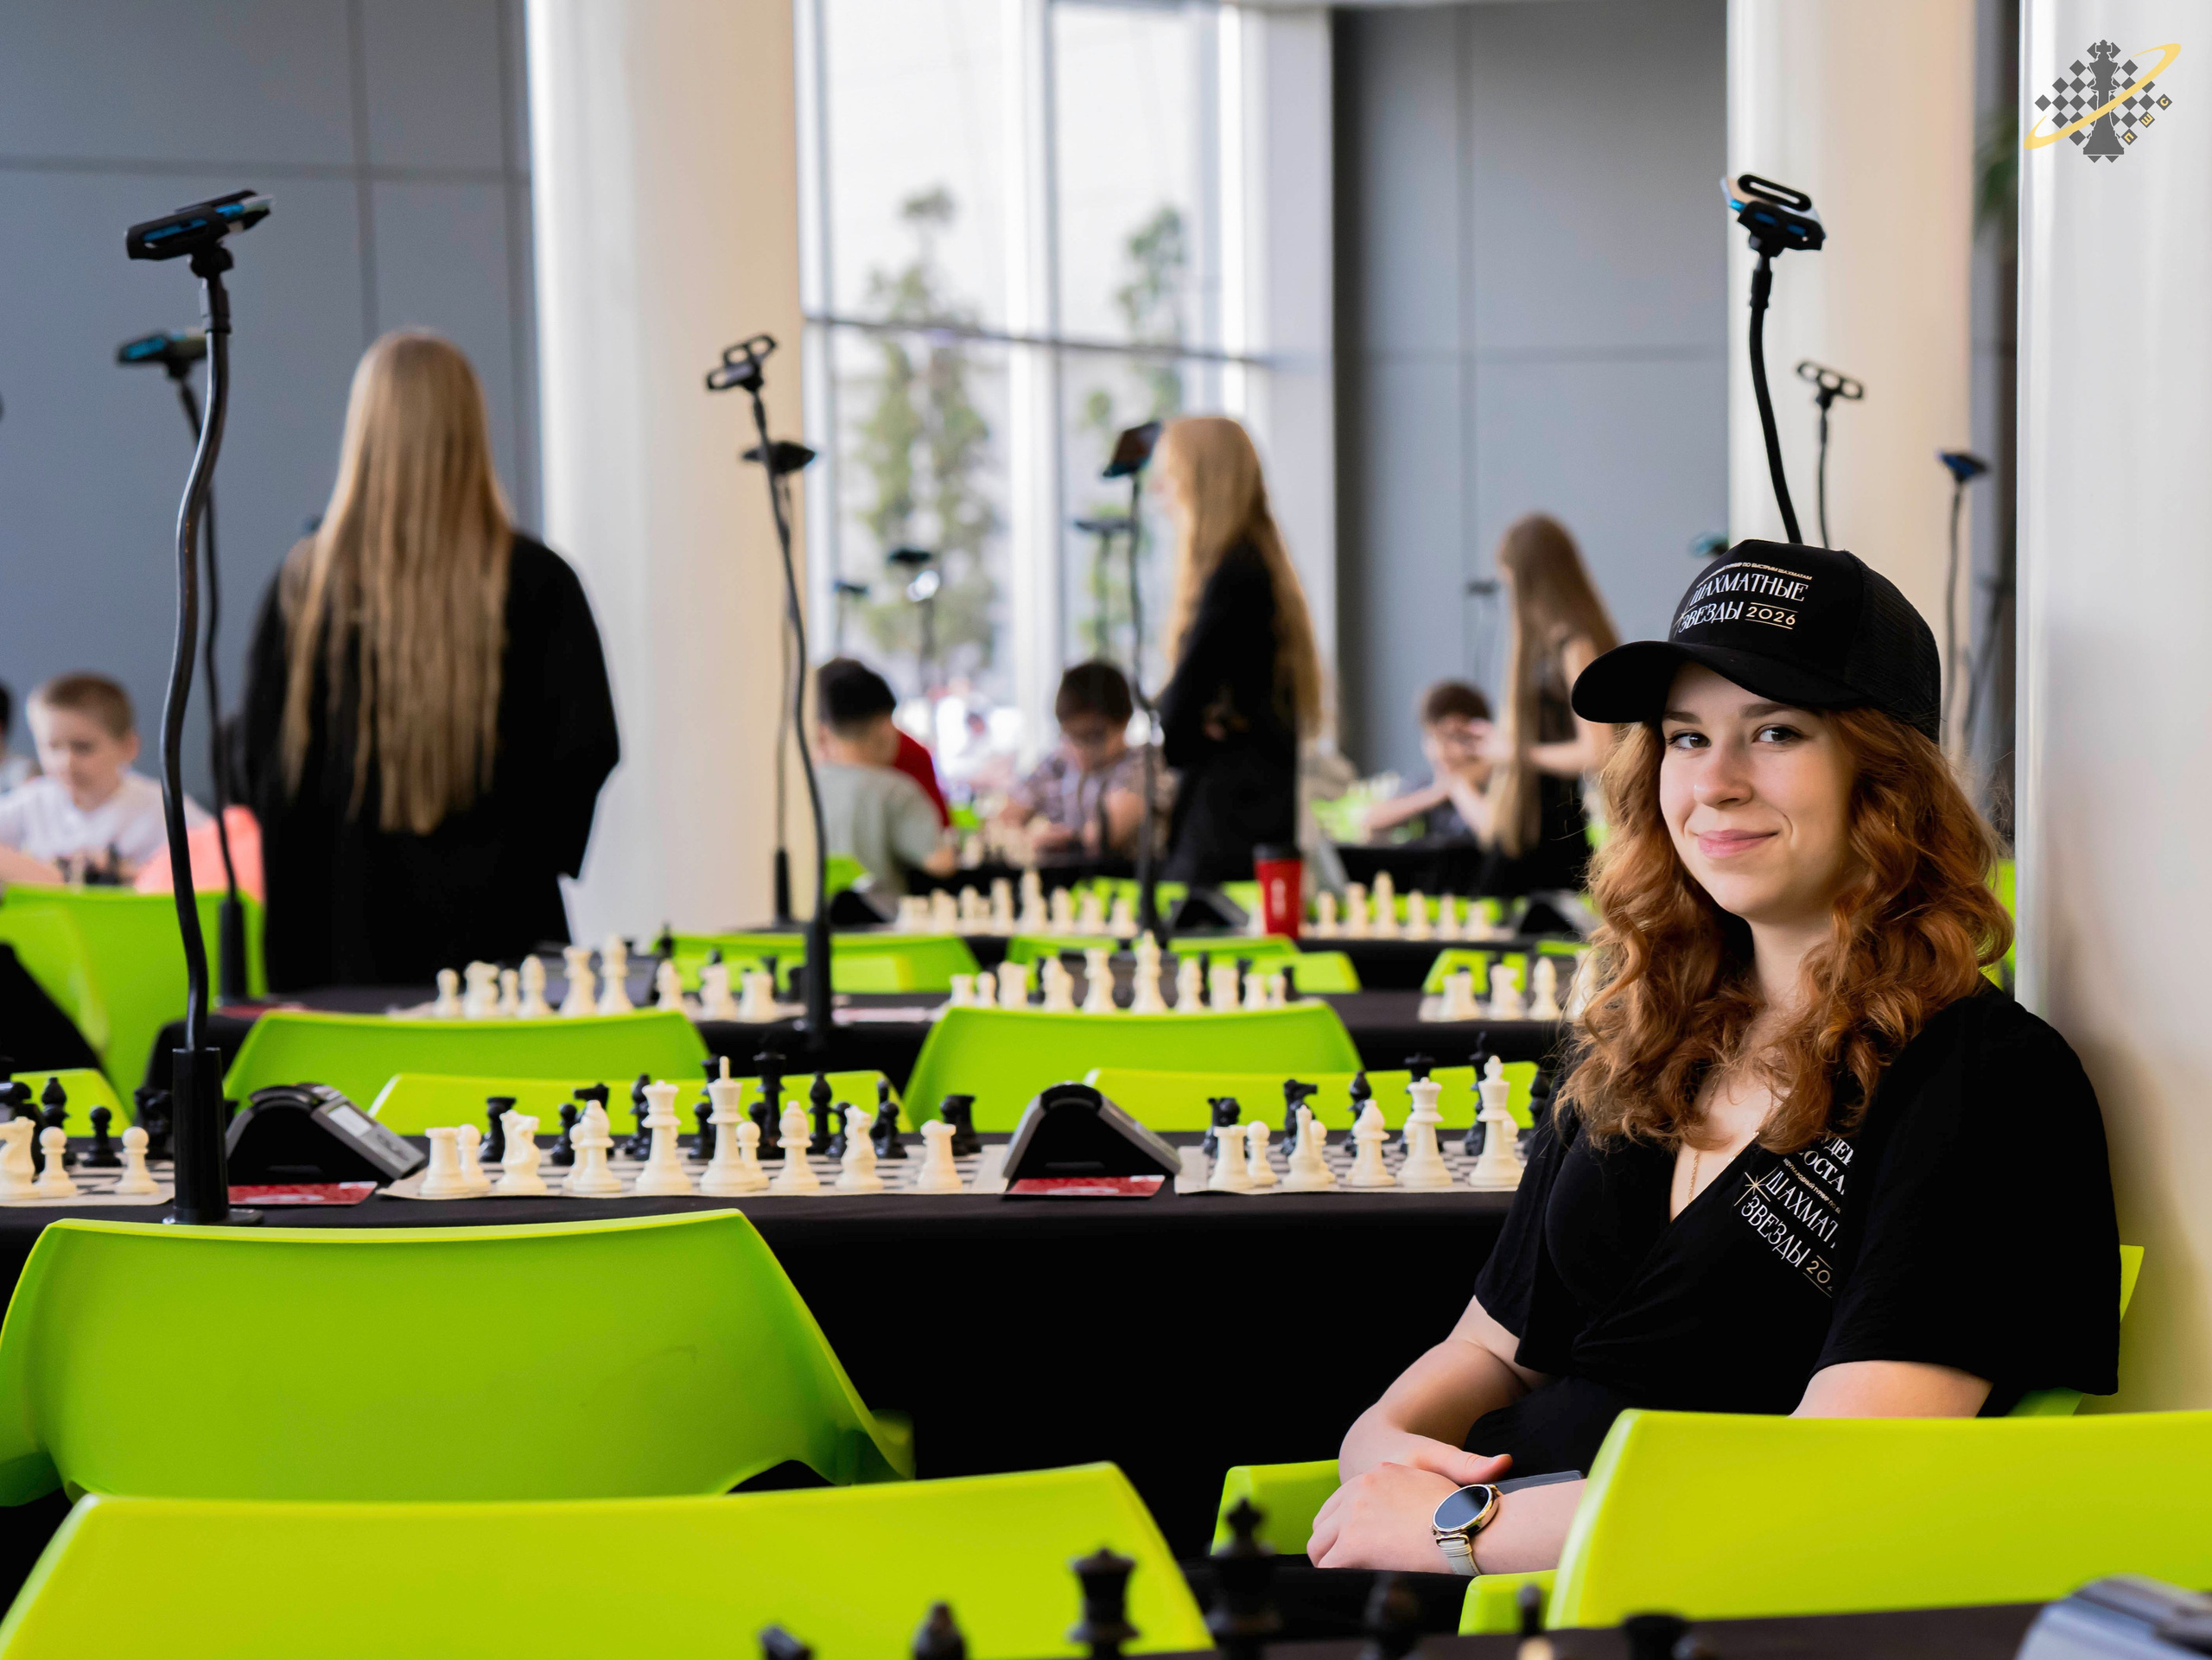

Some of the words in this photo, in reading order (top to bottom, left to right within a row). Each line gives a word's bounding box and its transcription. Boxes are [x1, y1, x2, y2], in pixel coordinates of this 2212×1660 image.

[1688, 572, 1809, 607] ШАХМАТНЫЕ
[1678, 601, 1745, 633] ЗВЕЗДЫ
[1745, 606, 1796, 626] 2026
[1798, 1150, 1845, 1195] ОСТА
[1740, 1194, 1811, 1268] ЗВЕЗДЫ
[1765, 1170, 1839, 1250] ШАХМАТ
